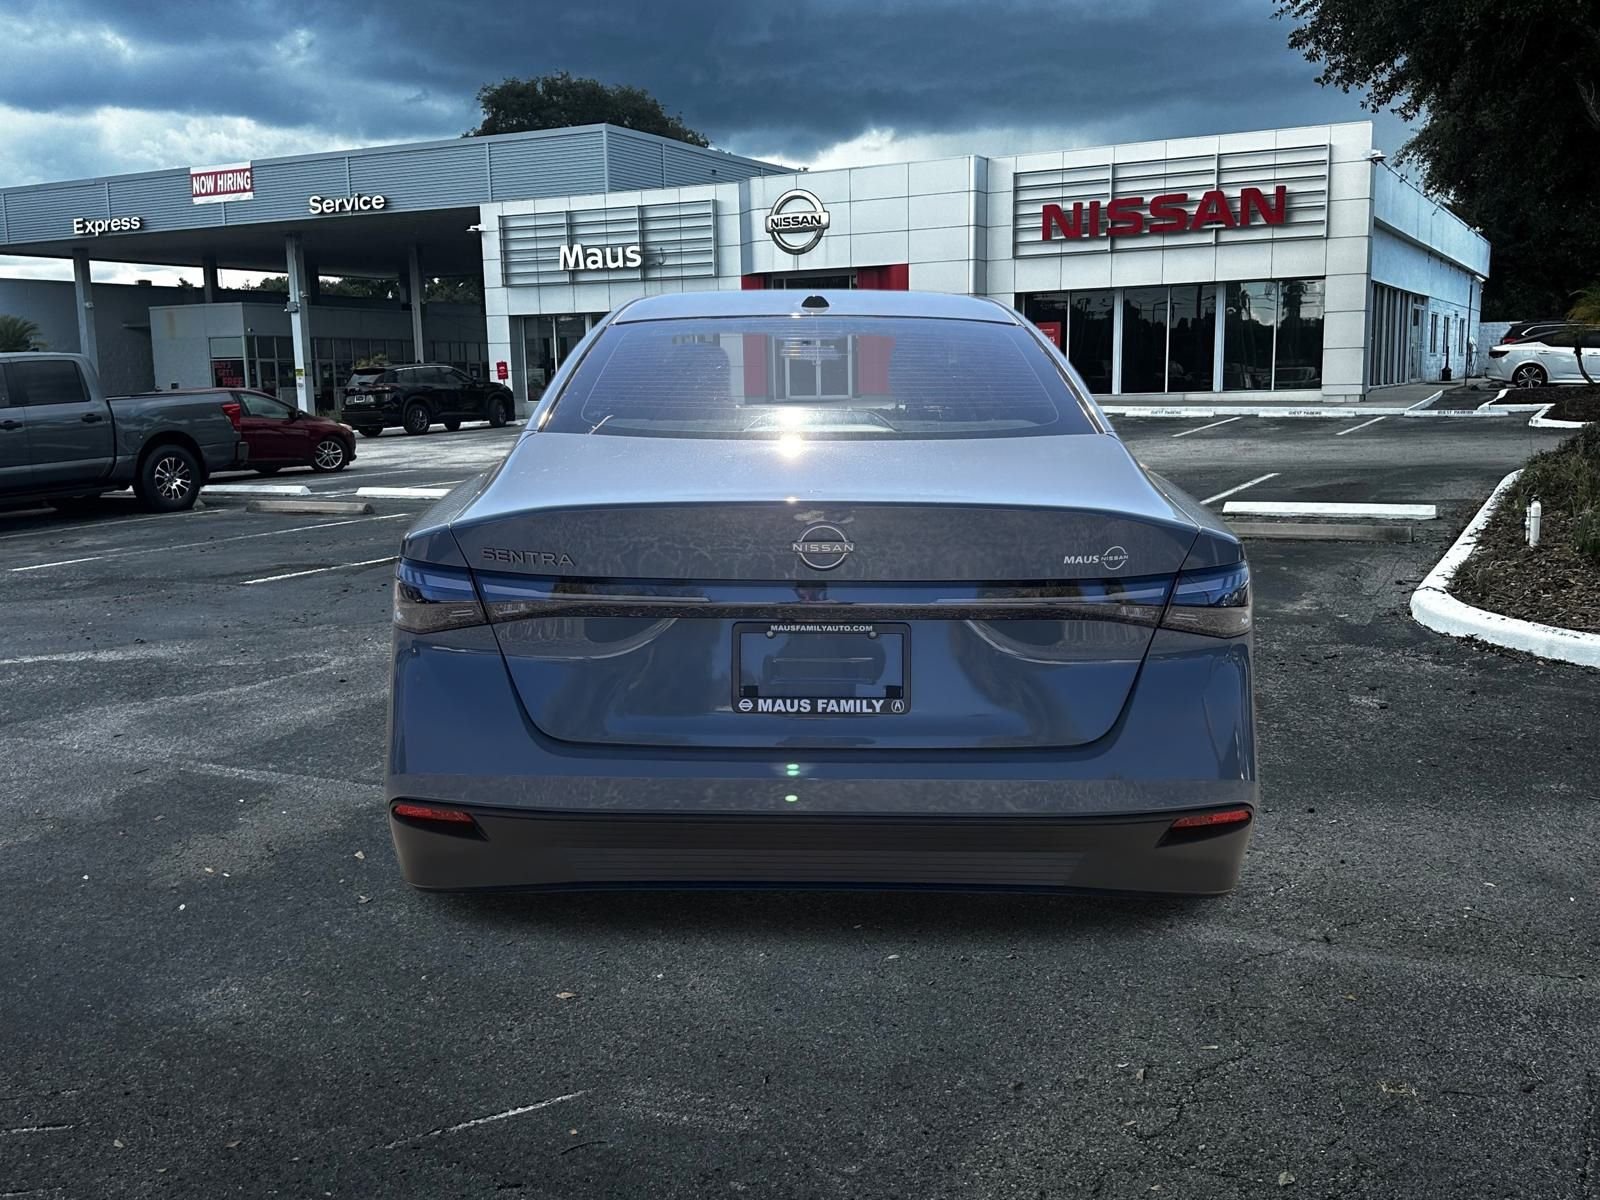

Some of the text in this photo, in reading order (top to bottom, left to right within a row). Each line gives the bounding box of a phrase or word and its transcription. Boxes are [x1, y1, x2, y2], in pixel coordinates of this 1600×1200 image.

[193, 169, 251, 194] NOW HIRING
[309, 193, 386, 215] Service
[1042, 185, 1287, 241] NISSAN
[73, 216, 141, 236] Express
[770, 214, 822, 229] NISSAN
[559, 243, 642, 271] Maus
[481, 547, 576, 568] SENTRA
[792, 543, 854, 552] NISSAN
[1063, 555, 1099, 564] MAUS
[758, 699, 884, 712] MAUS FAMILY
